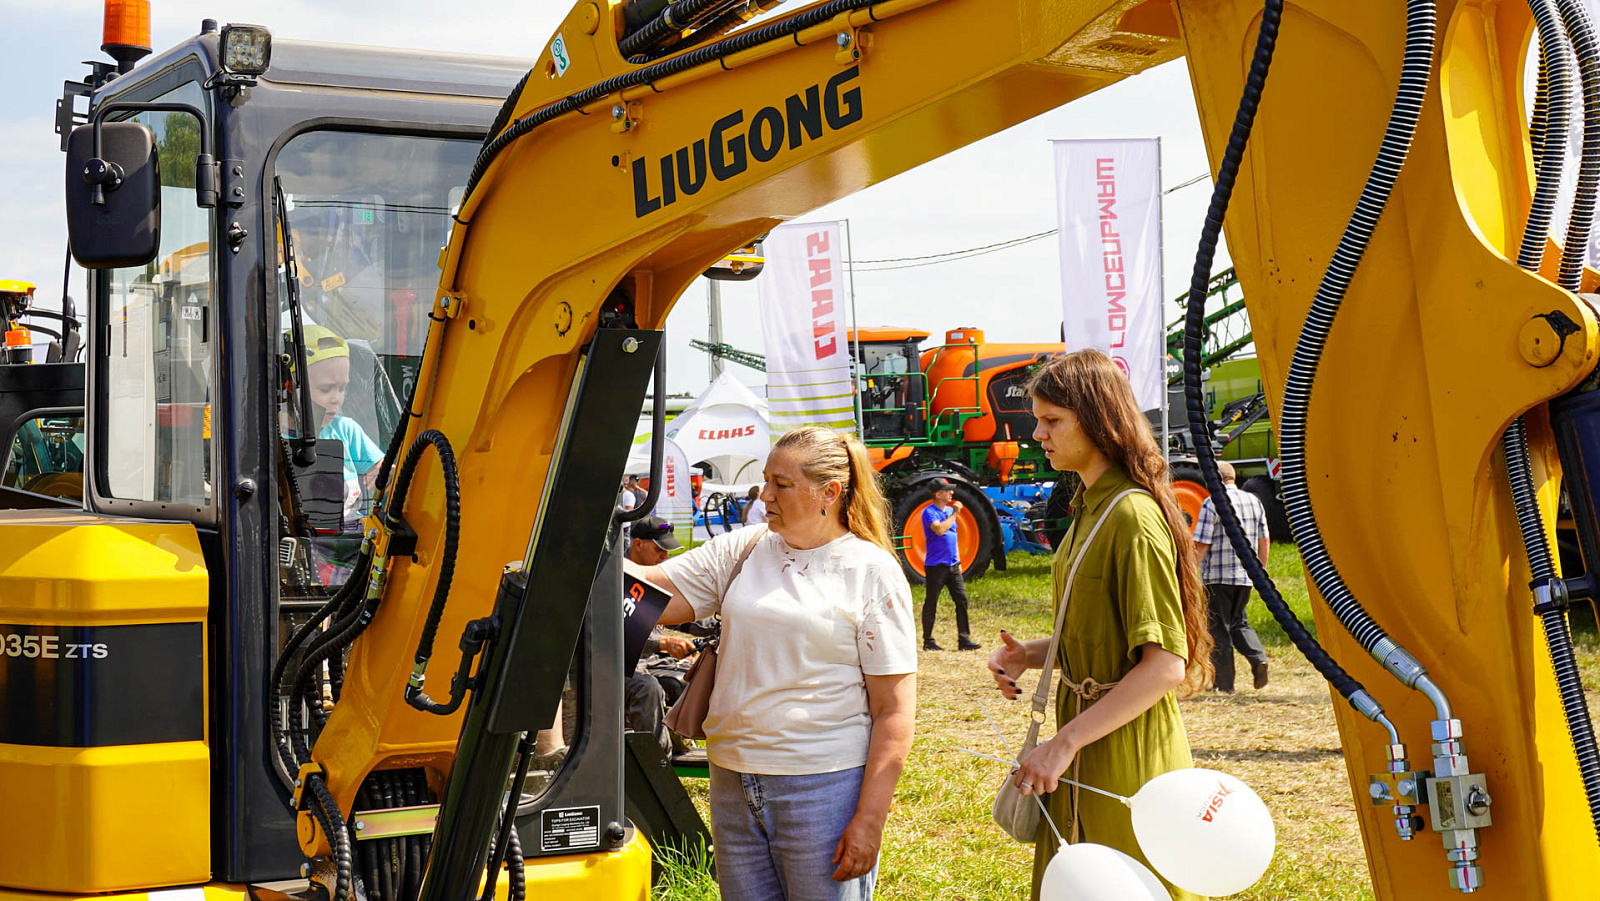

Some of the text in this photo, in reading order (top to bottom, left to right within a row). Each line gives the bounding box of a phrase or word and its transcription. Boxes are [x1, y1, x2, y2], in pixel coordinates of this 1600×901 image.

[1005, 385, 1024, 397] Sta
[698, 425, 755, 440] CLAAS
[65, 643, 108, 659] ZTS
